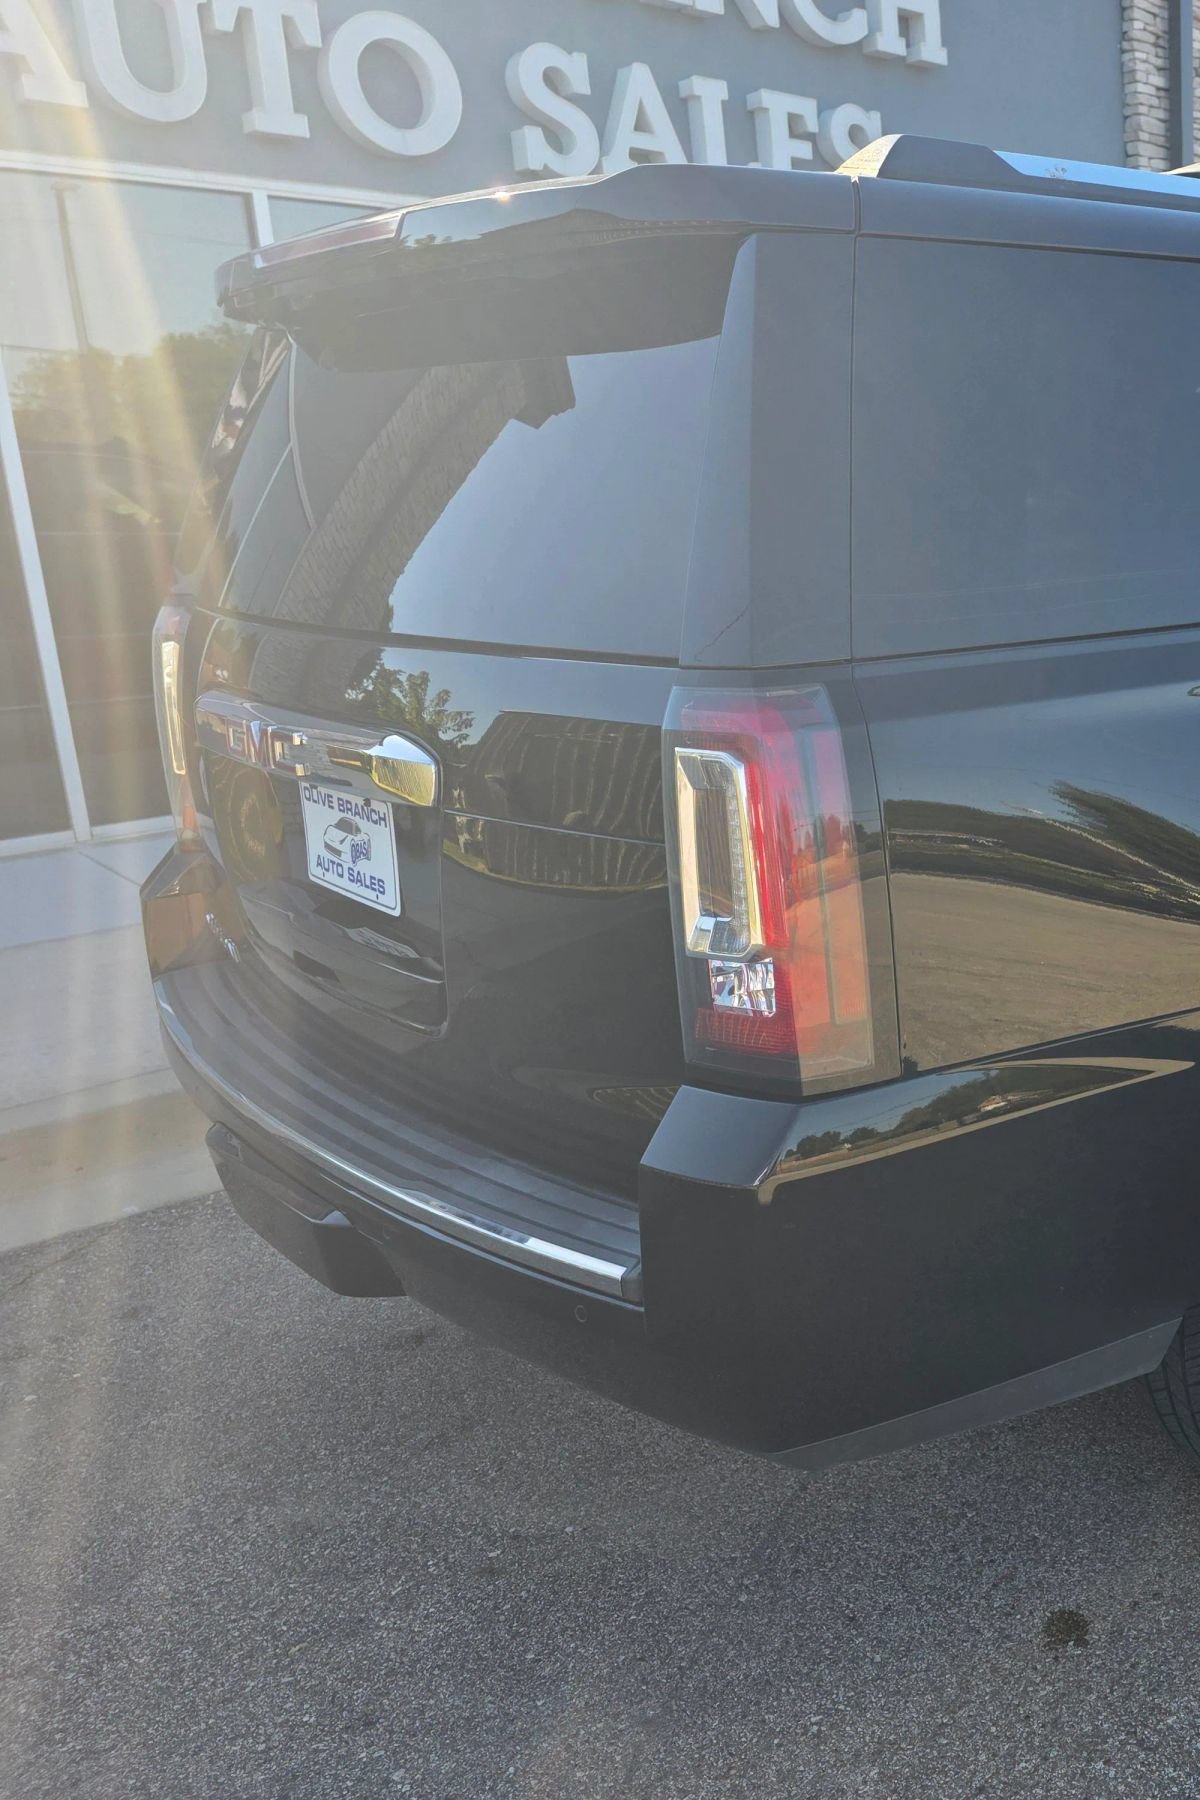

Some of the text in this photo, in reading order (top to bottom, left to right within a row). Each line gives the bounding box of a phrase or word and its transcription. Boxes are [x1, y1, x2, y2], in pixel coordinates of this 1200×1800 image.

[505, 42, 882, 176] SALES
[303, 786, 388, 828] OLIVE BRANCH
[316, 854, 386, 896] AUTO SALES
